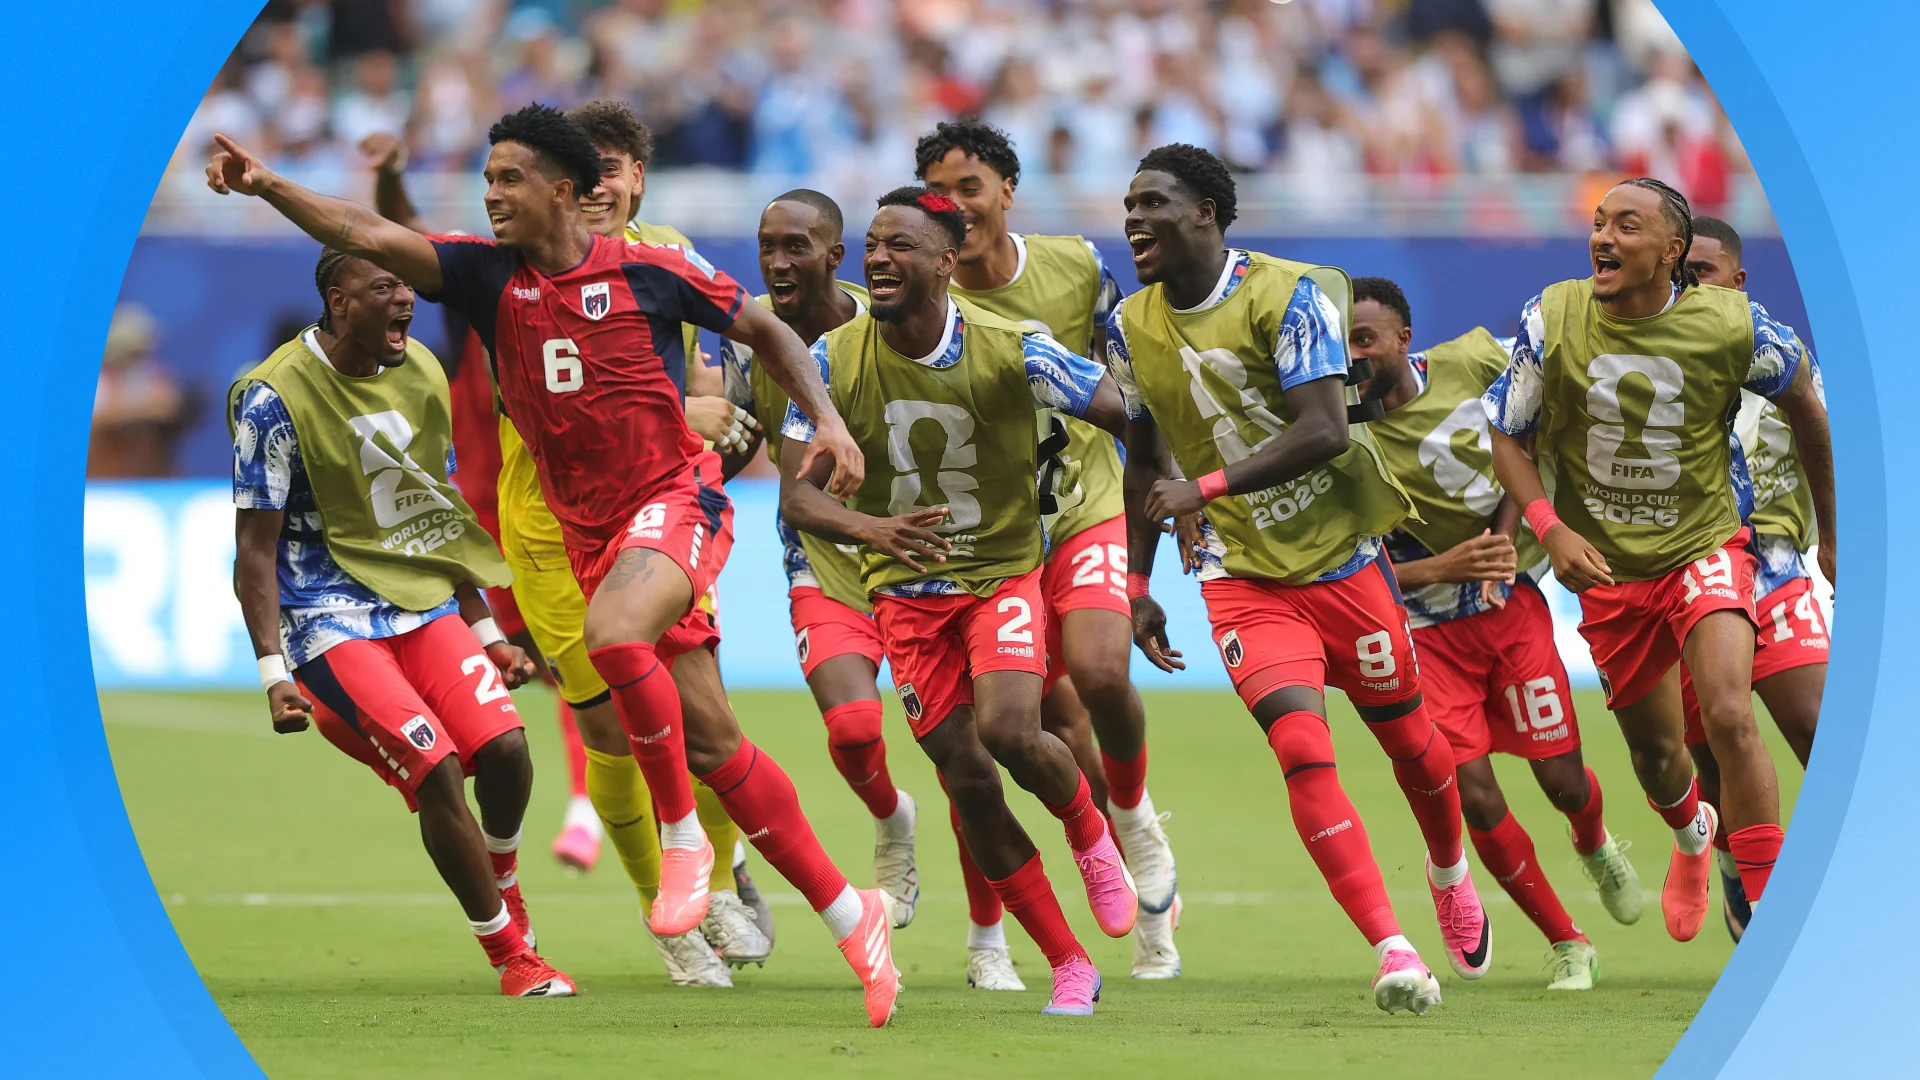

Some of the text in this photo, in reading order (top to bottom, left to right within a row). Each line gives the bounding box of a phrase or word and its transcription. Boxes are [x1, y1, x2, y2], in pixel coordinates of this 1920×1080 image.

[542, 338, 584, 394] 6
[1610, 462, 1655, 479] FIFA
[394, 493, 436, 512] FIFA
[1251, 468, 1334, 531] 2026
[1583, 498, 1680, 528] 2026
[1584, 483, 1680, 507] WORLD CUP
[380, 518, 430, 550] WORLD
[1071, 542, 1128, 588] 25
[1682, 547, 1733, 605] 19
[997, 596, 1034, 644] 2
[1770, 590, 1824, 643] 14
[997, 645, 1034, 658] capelli
[1355, 629, 1397, 678] 8
[460, 653, 512, 706] 2
[1360, 677, 1400, 690] capelli
[1505, 675, 1565, 733] 16
[1532, 723, 1569, 741] capelli
[1309, 818, 1352, 843] capelli
